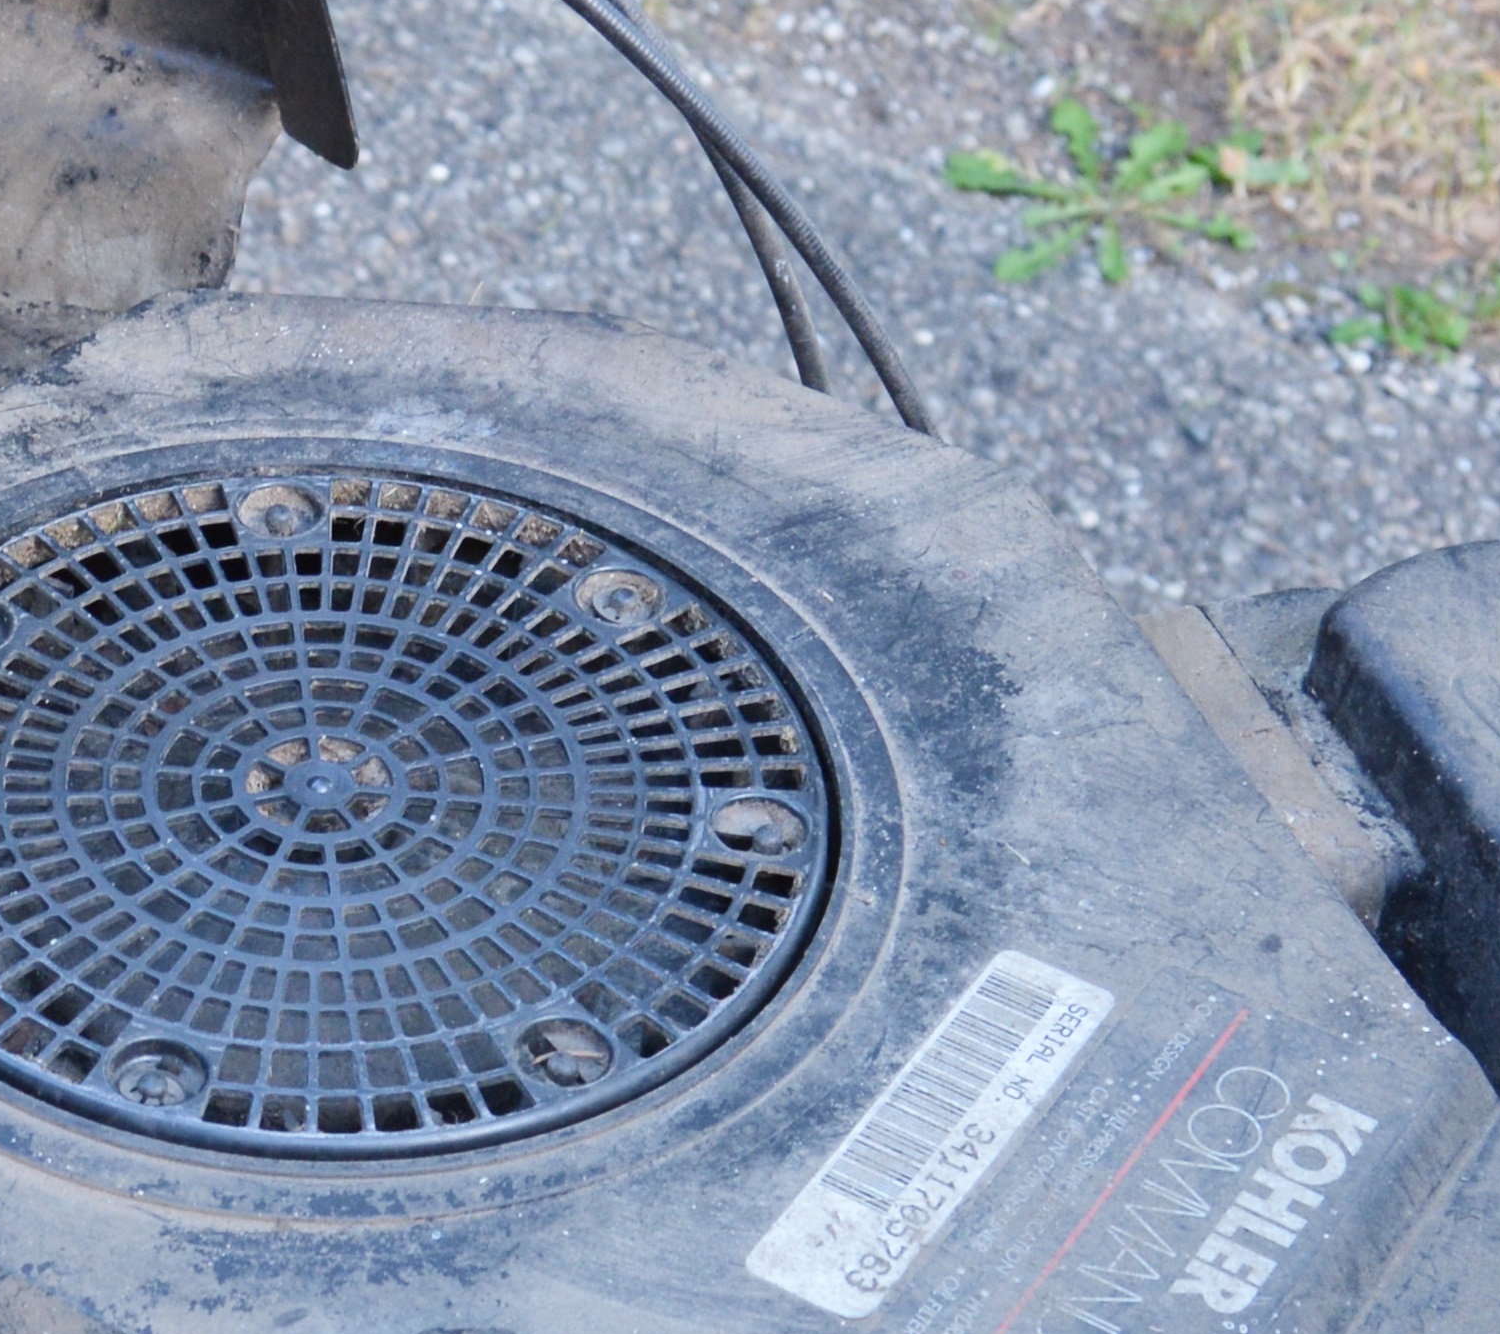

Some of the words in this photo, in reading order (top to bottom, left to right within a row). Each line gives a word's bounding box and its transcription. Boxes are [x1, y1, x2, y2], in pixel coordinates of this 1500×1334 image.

[1022, 1001, 1089, 1069] SERIAL
[1143, 1030, 1192, 1082] DESIGN
[992, 1073, 1033, 1110] NO.
[839, 1120, 998, 1297] 3411705763
[1166, 1087, 1380, 1322] KOHLER
[931, 1273, 964, 1299] OIL
